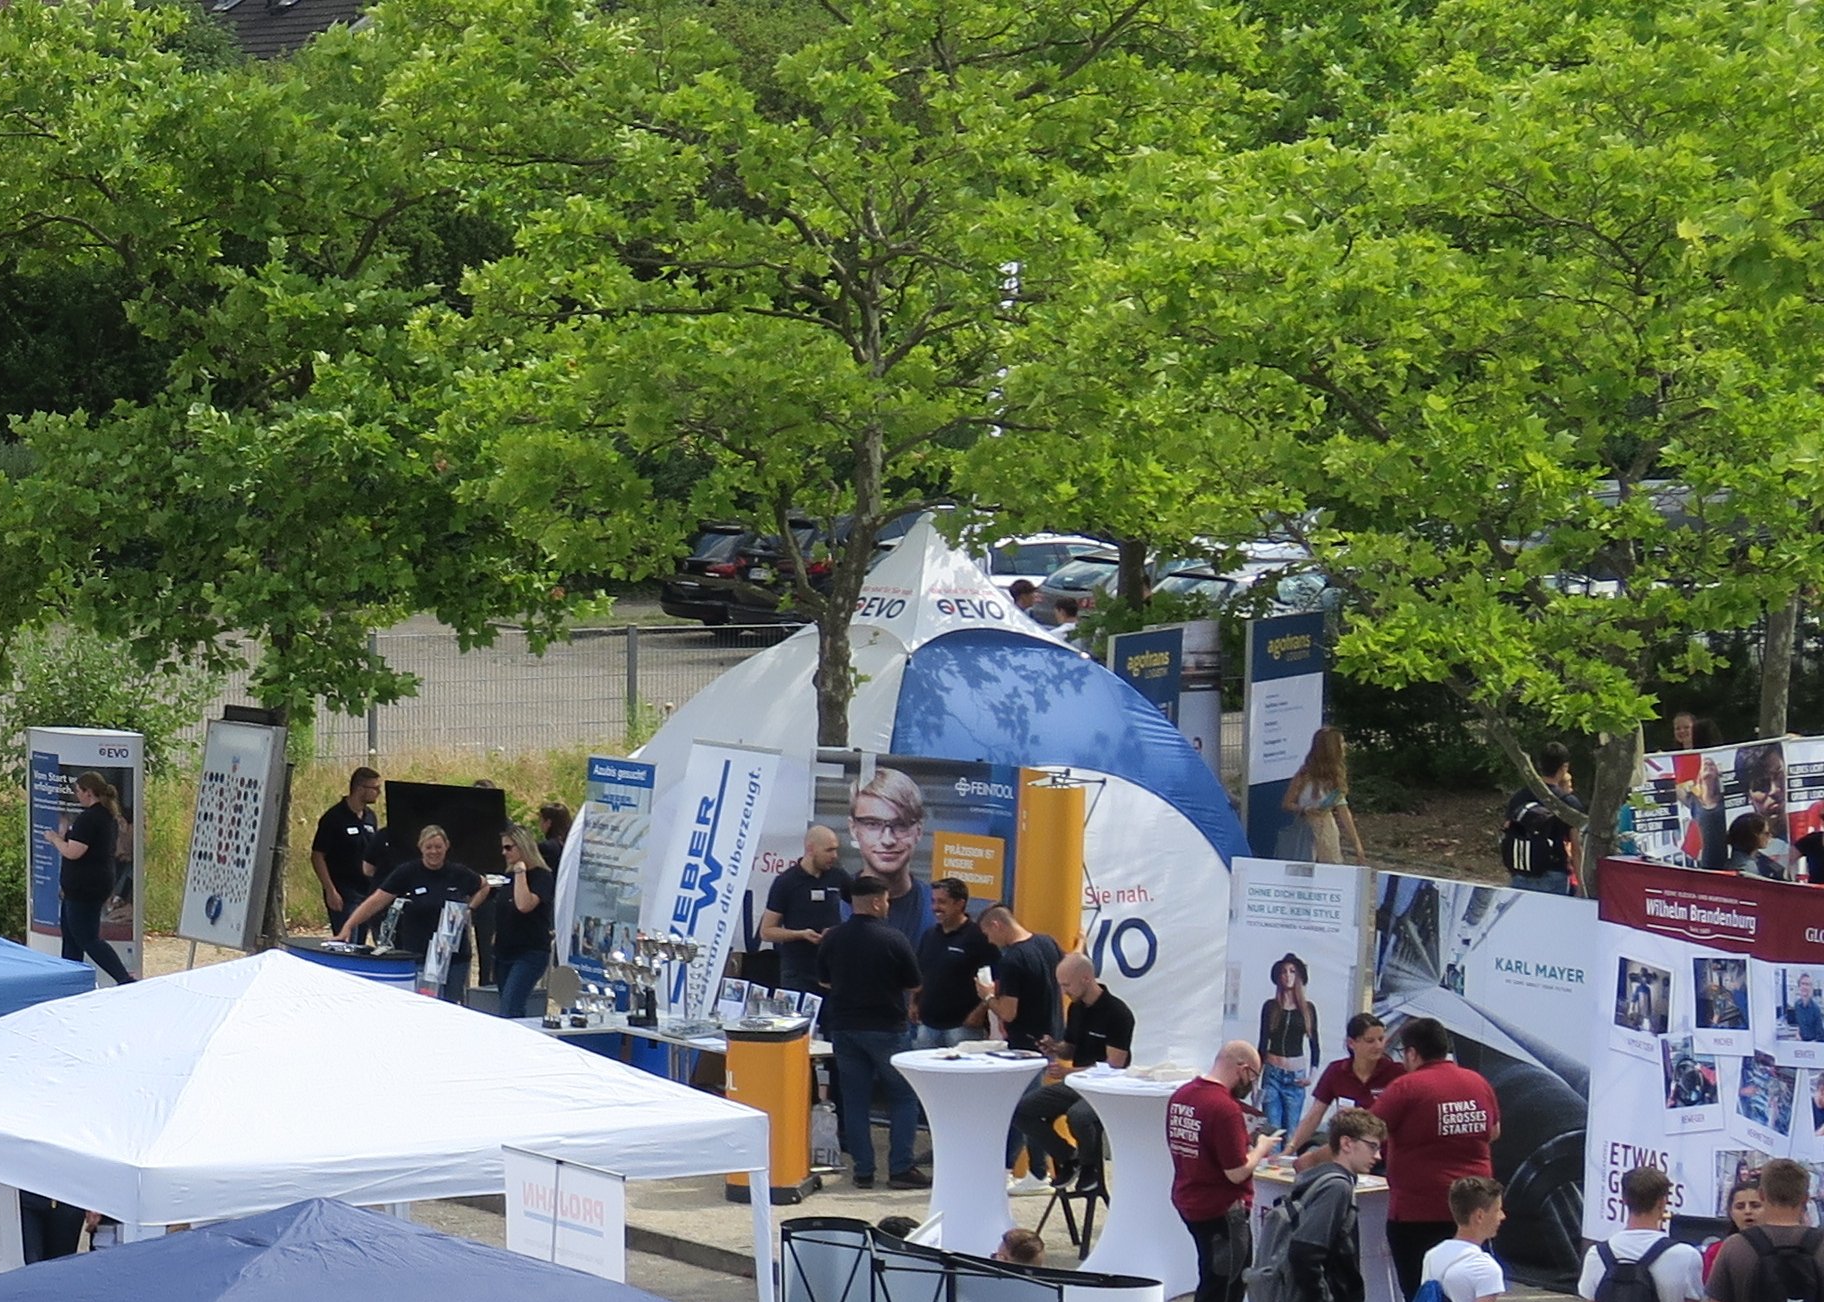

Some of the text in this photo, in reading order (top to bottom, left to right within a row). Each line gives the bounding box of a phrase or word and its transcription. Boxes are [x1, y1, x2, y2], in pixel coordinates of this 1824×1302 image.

[860, 597, 906, 618] EVO
[958, 599, 1004, 620] EVO
[106, 748, 129, 758] EVO
[971, 781, 1014, 800] FEINTOOL
[1116, 887, 1155, 904] nah.
[1646, 897, 1756, 934] Wilhelm Brandenburg
[1494, 957, 1585, 984] KARL MAYER
[1442, 1100, 1476, 1112] ETWAS
[1442, 1110, 1487, 1124] GROSSES
[1442, 1122, 1487, 1136] STARTEN
[1610, 1142, 1669, 1175] ETWAS
